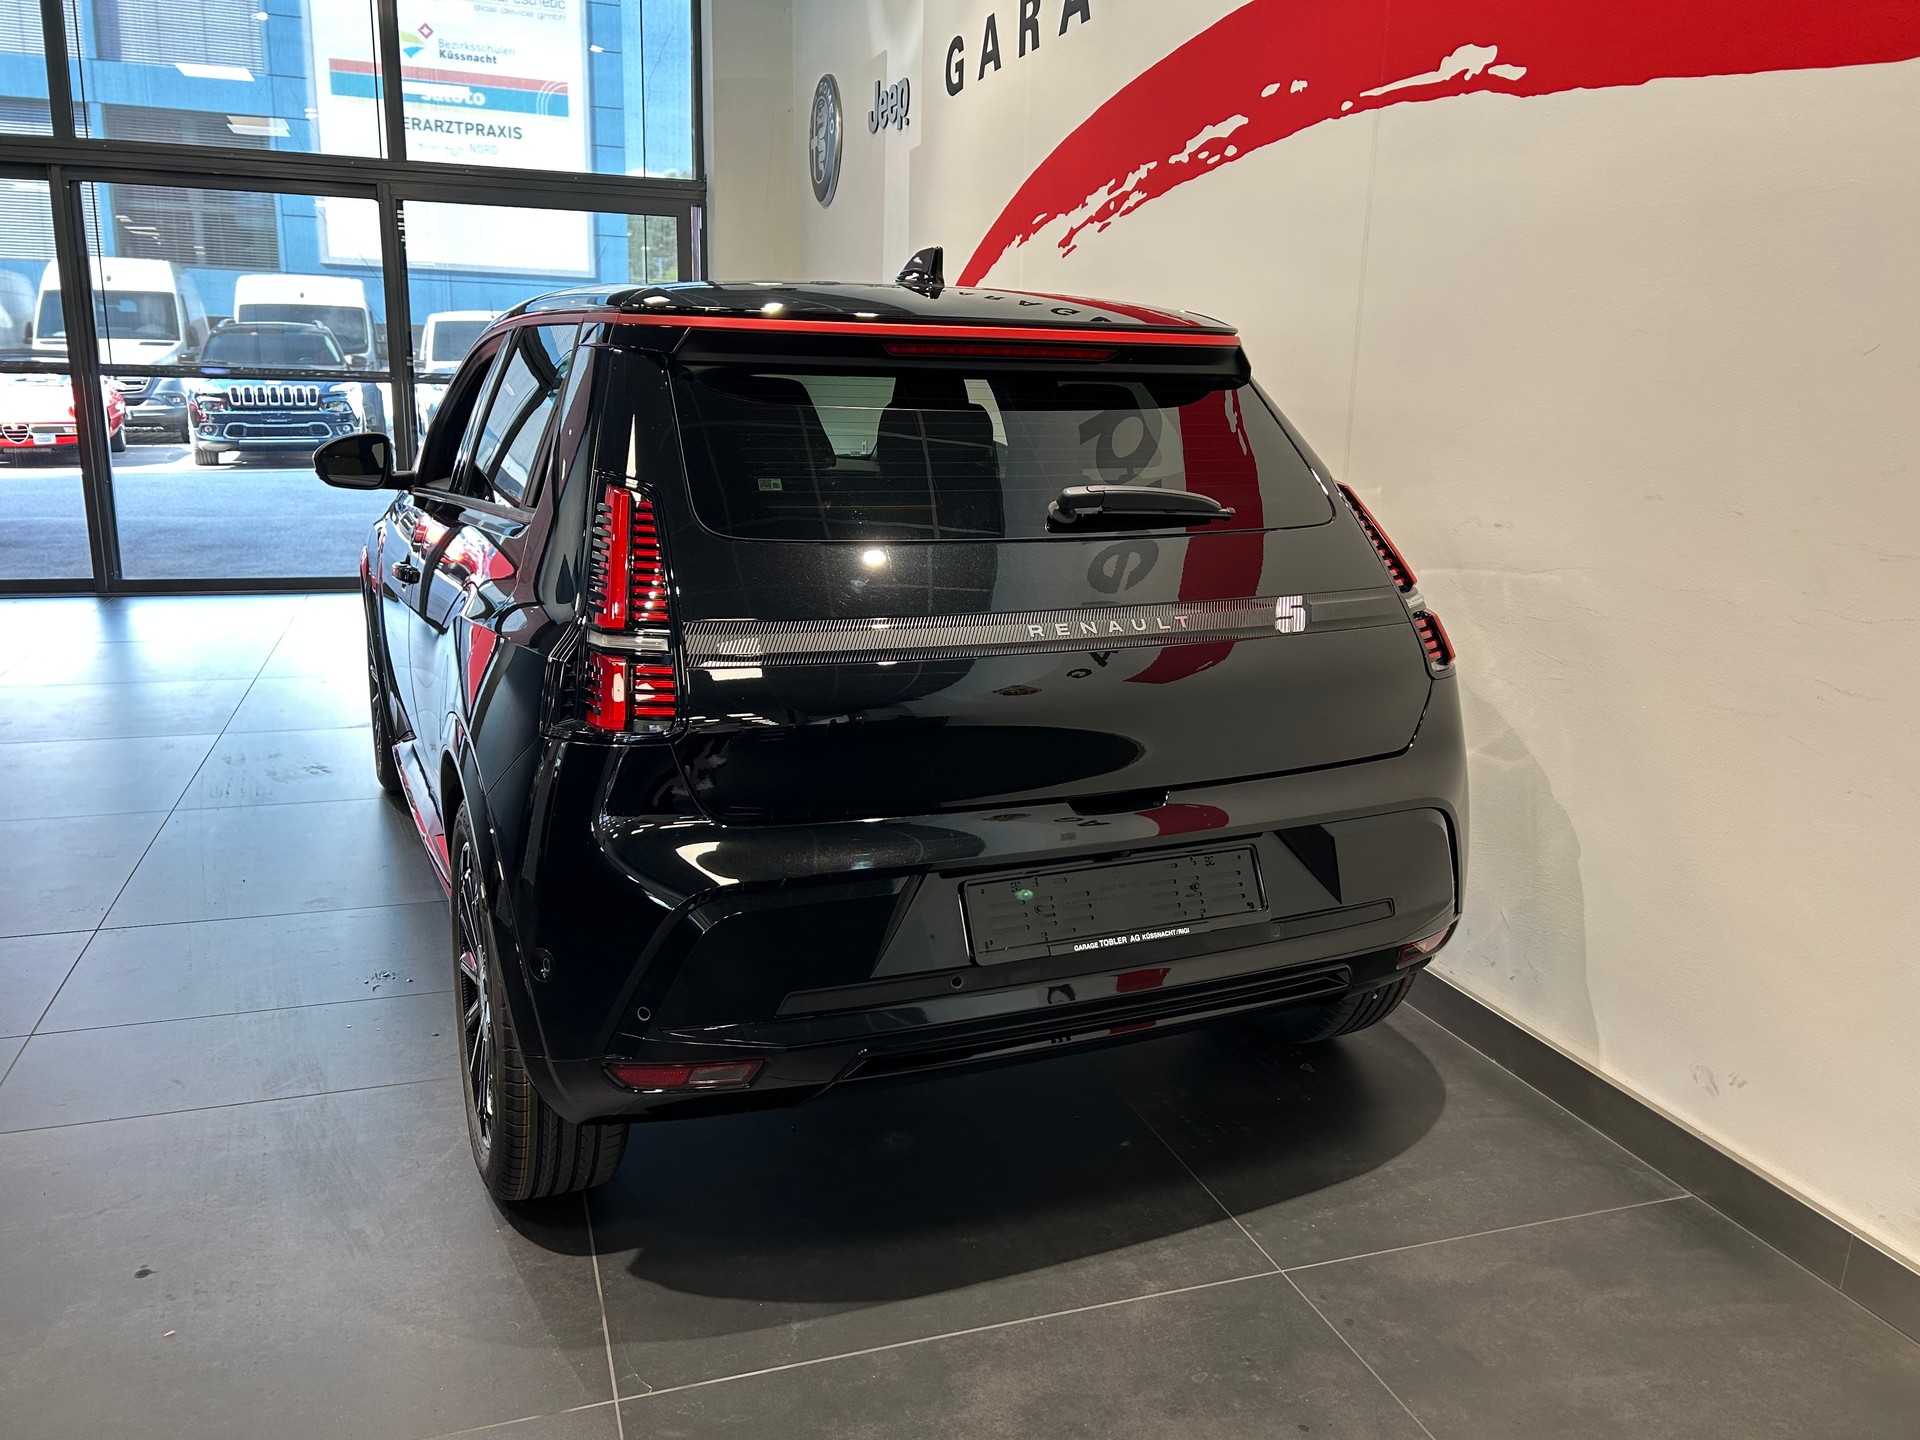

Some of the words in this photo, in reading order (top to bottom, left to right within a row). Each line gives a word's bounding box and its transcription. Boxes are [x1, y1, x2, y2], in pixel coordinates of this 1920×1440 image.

[438, 38, 516, 56] Bezirksschulen
[439, 50, 498, 64] Küssnacht
[945, 0, 1091, 97] GARA
[867, 77, 910, 134] Jeep
[1028, 615, 1188, 638] RENAULT
[1073, 942, 1099, 952] GARAGE
[1099, 936, 1128, 947] TOBLER
[1130, 934, 1141, 943] AG
